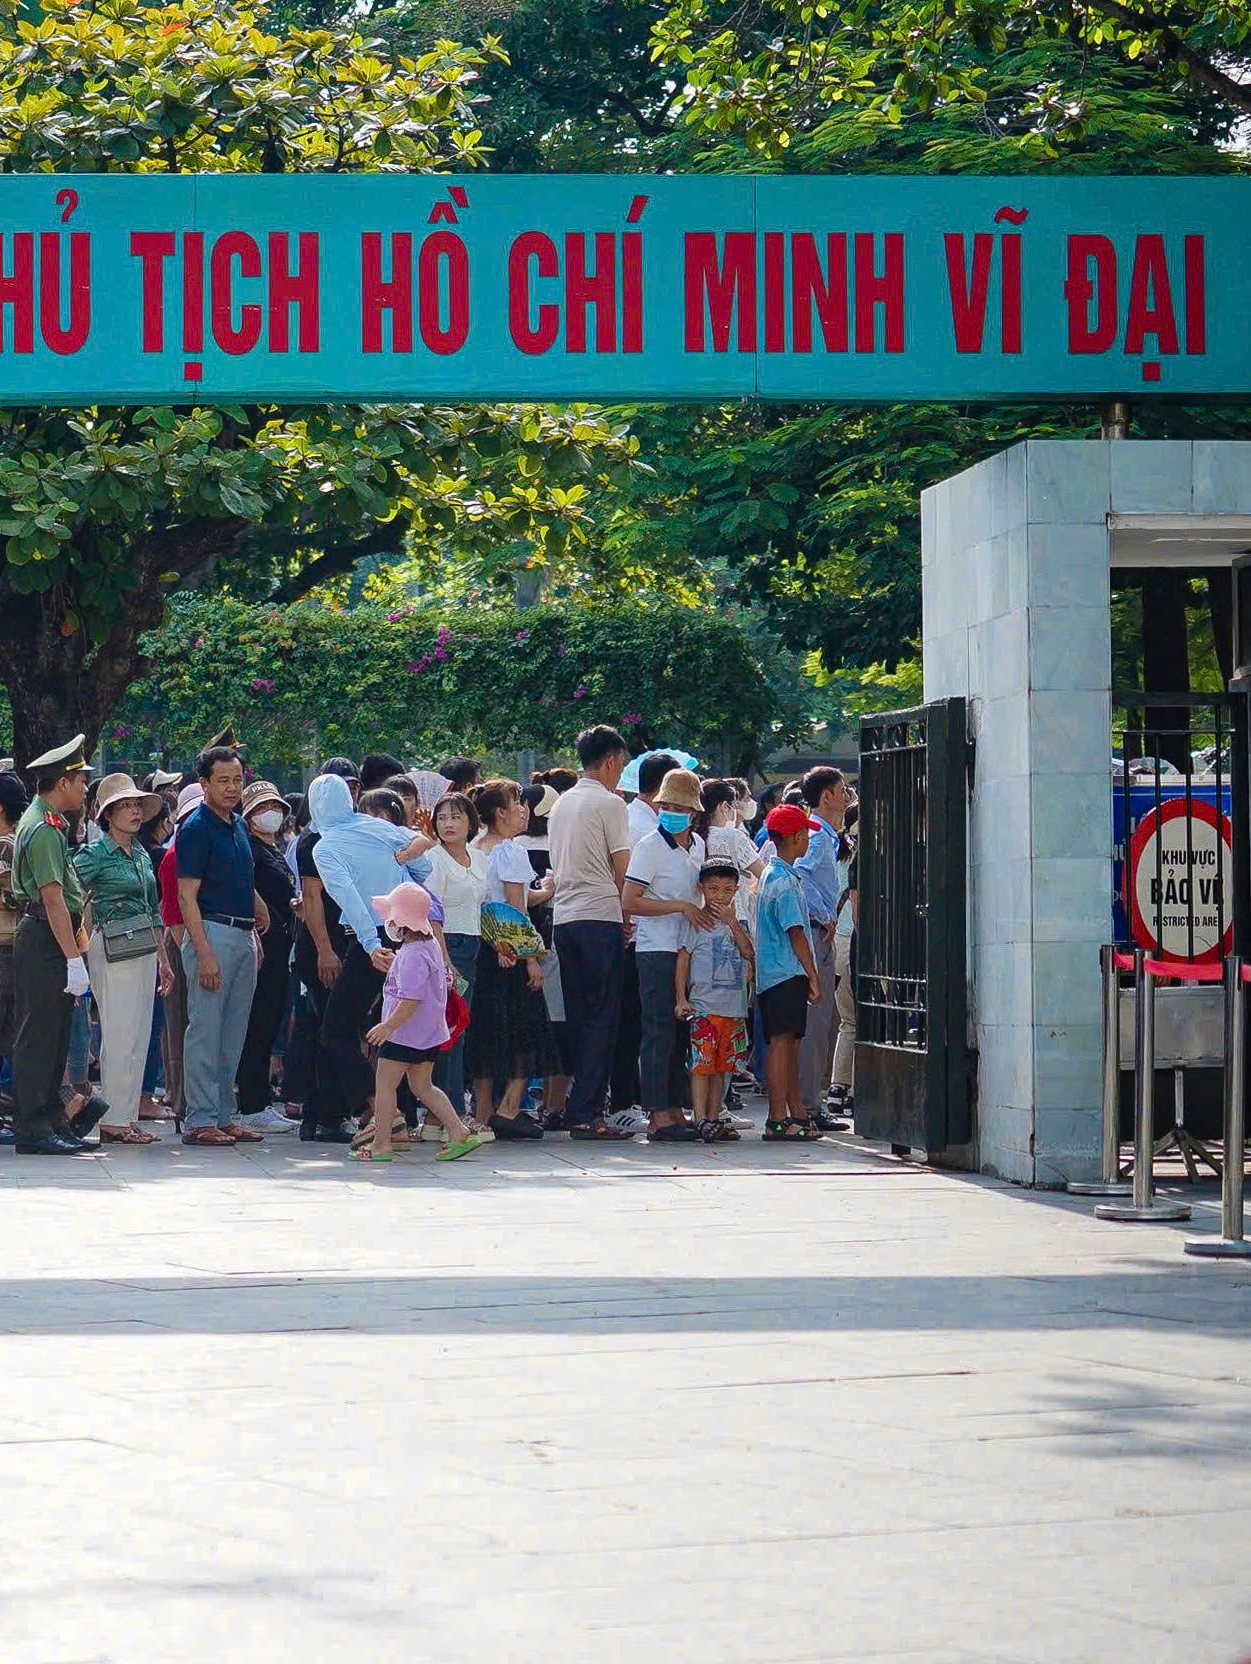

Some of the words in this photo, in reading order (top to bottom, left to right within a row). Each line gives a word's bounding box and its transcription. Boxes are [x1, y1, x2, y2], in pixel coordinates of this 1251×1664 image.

[130, 231, 321, 382] TỊCH
[361, 185, 470, 355] HỒ
[508, 195, 643, 355] CHÍ
[684, 233, 905, 353] MINH
[944, 206, 1031, 353] VĨ
[1064, 234, 1206, 382] ĐẠI
[1162, 850, 1187, 866] KHU
[1191, 849, 1216, 869] VỰC
[1152, 916, 1200, 927] RSTRICED
[1202, 916, 1219, 927] ARE
